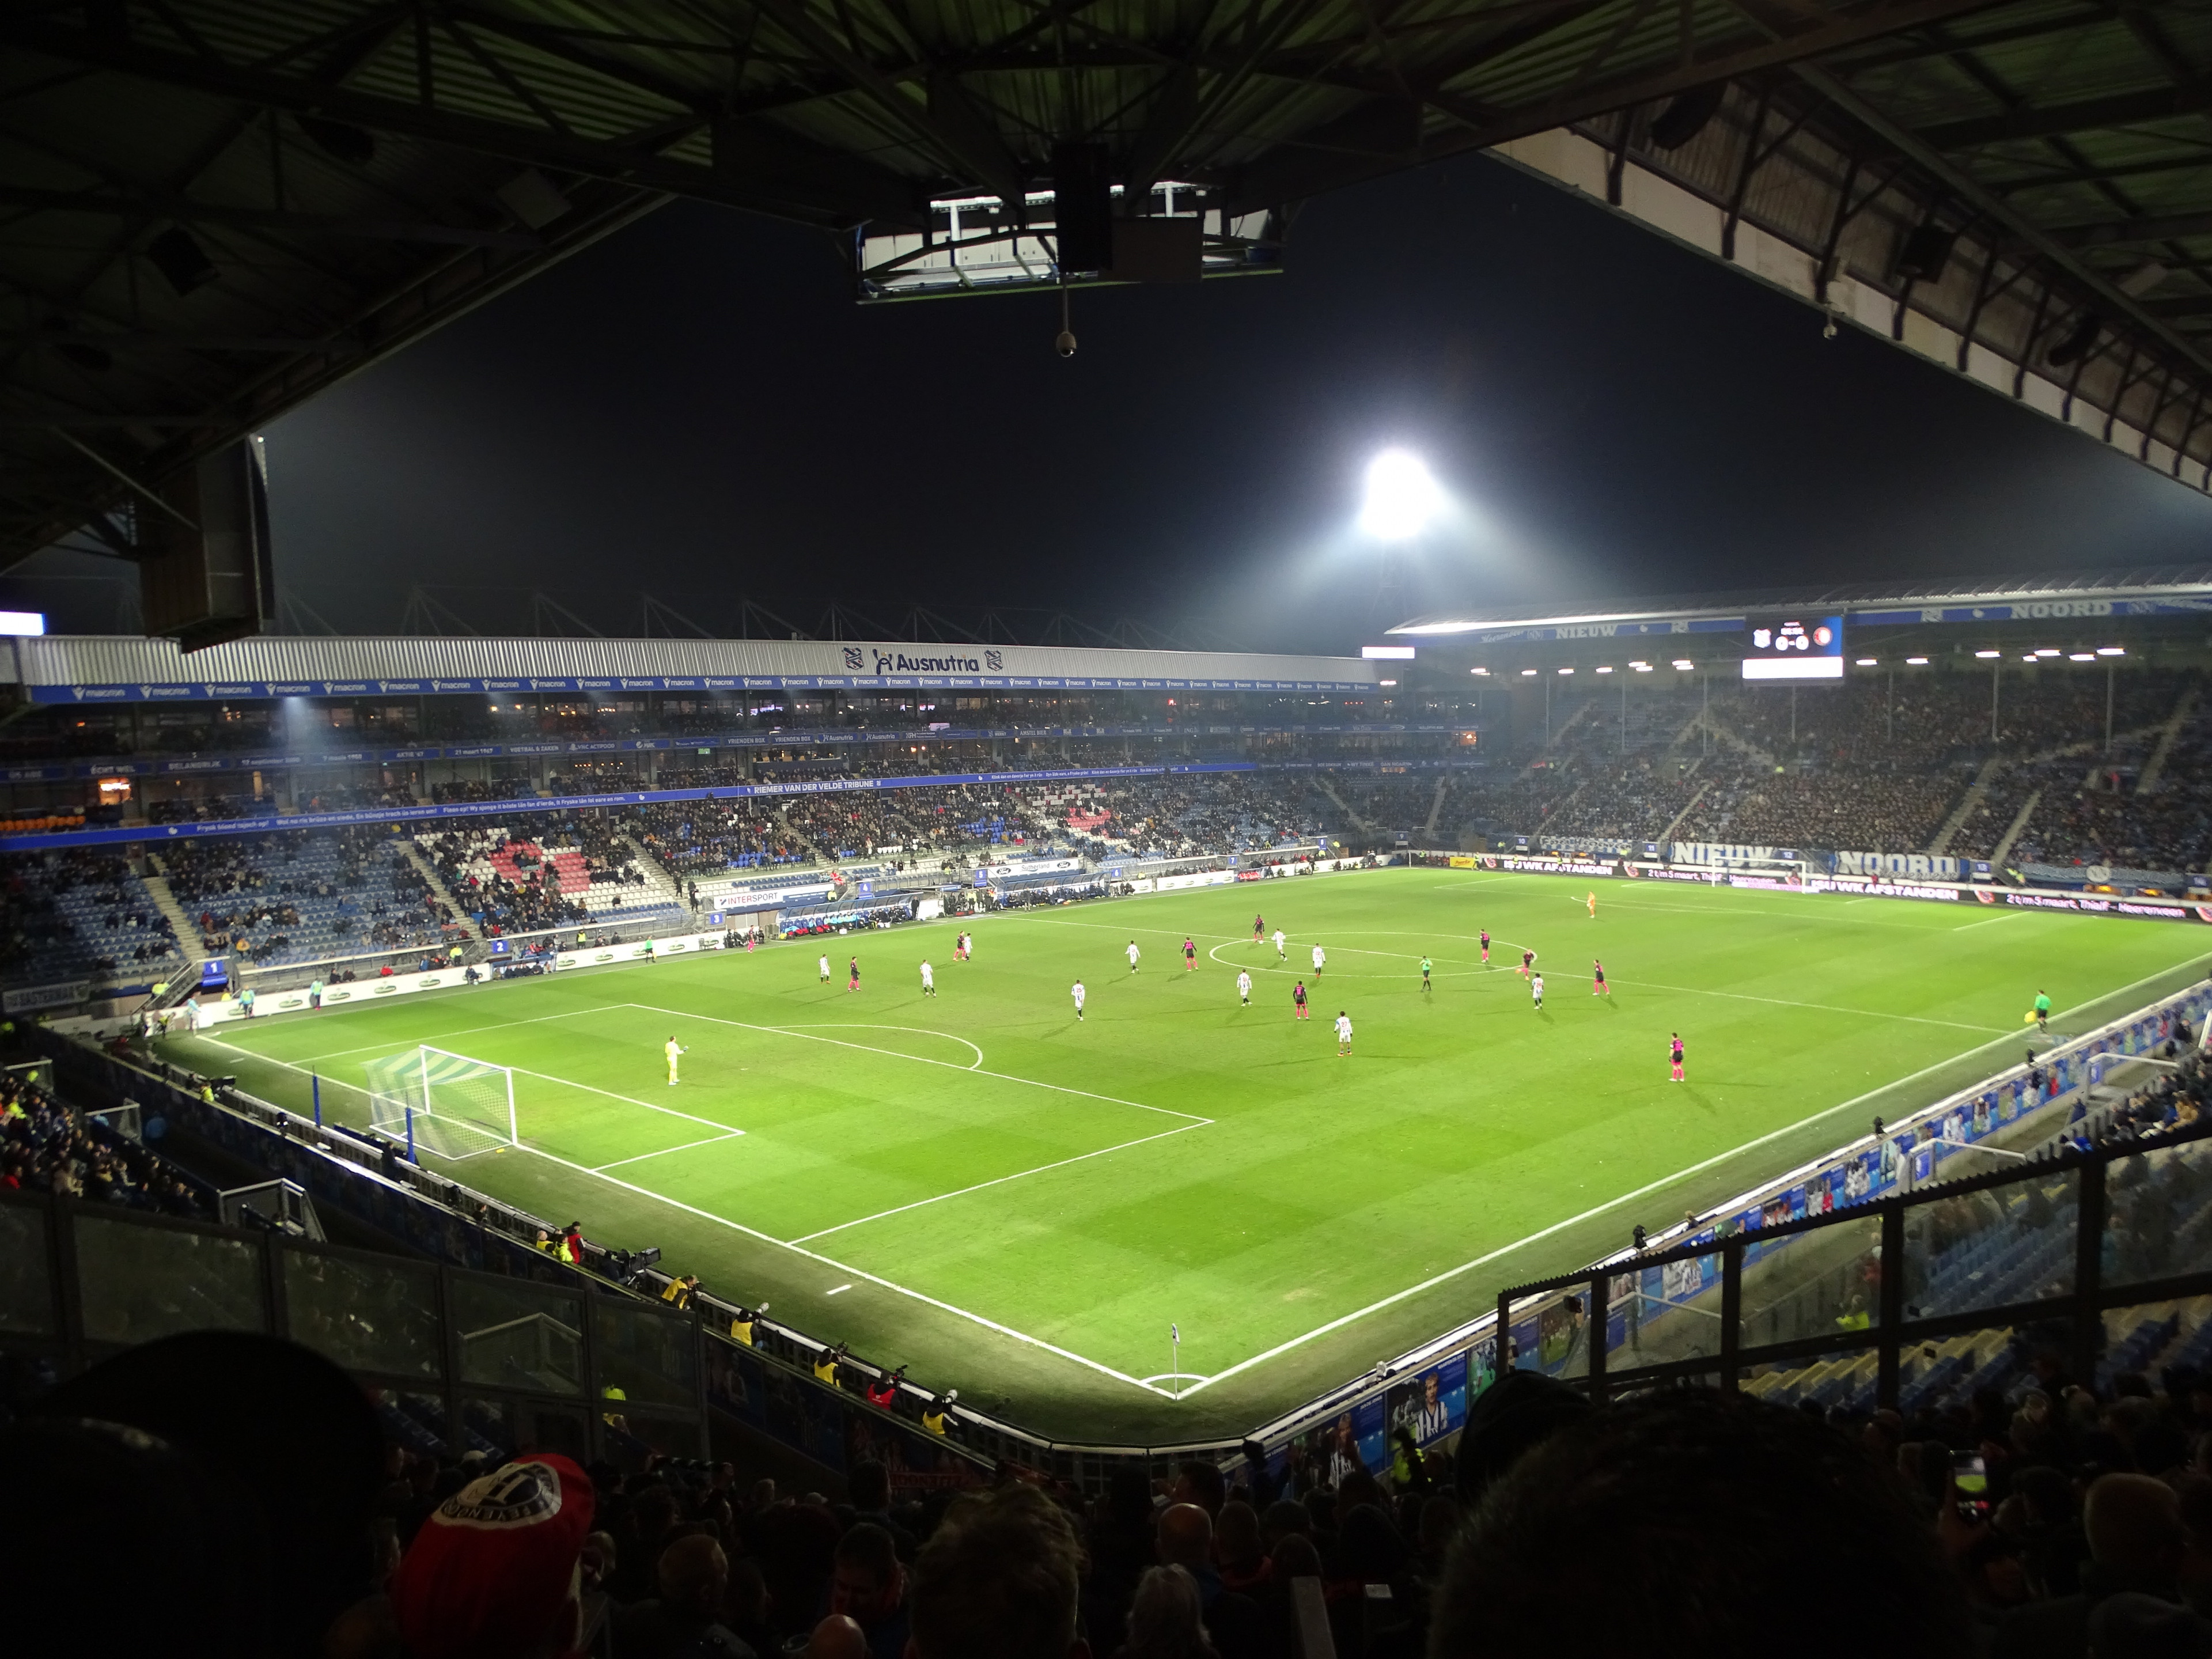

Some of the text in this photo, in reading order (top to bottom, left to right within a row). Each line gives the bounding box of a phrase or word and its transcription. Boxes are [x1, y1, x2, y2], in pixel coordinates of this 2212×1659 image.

[2011, 601, 2112, 619] NOORD
[1556, 624, 1616, 639] NIEUW
[897, 653, 979, 672] Ausnutria
[754, 781, 874, 794] RIEMER VAN DER VELDE TRIBUNE
[1673, 842, 1774, 869] NIEUW
[1523, 861, 1543, 870] WK
[1839, 851, 1956, 876] NOORD
[1648, 869, 1654, 877] 2
[1674, 872, 1700, 881] maart,
[1810, 880, 1836, 891] ISU
[1836, 881, 1865, 893] WK
[1865, 884, 1959, 901] AFSTANDEN
[728, 892, 778, 905] INTERSPORT
[2006, 894, 2186, 918] 2 t/m 5 maart, Thialf Heerenveen
[714, 915, 719, 923] 3
[497, 942, 503, 952] 2
[210, 963, 217, 972] 1
